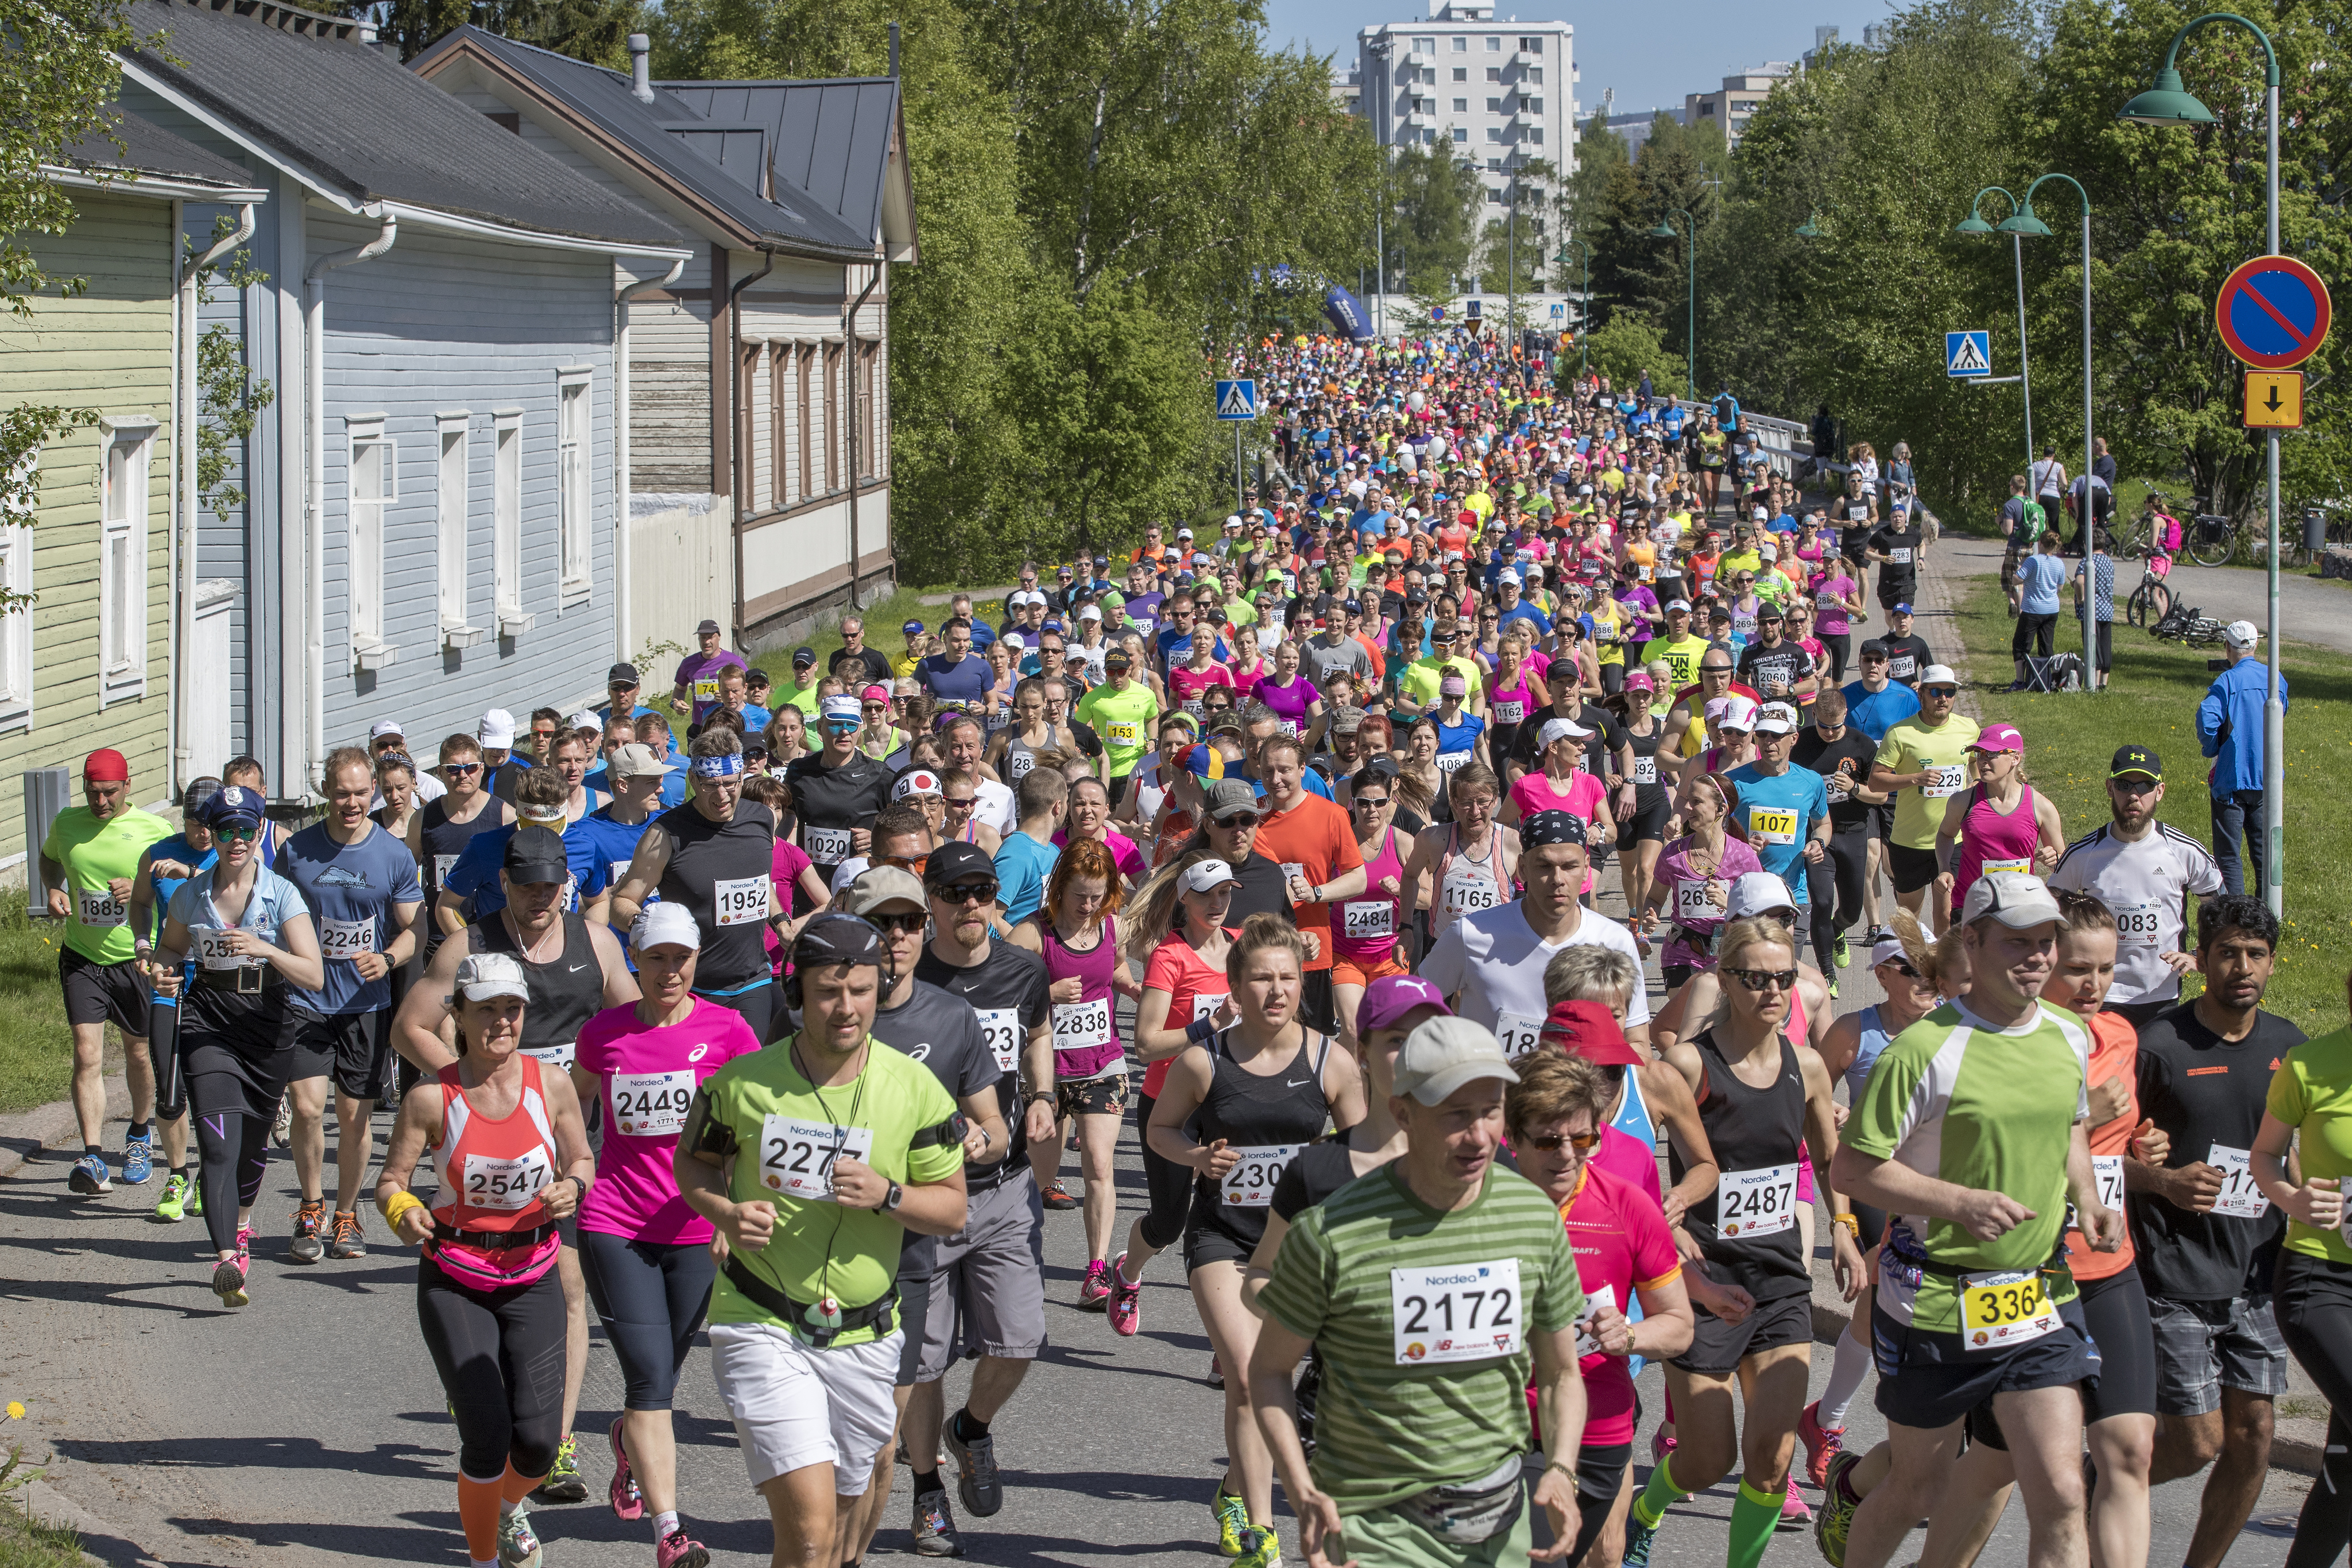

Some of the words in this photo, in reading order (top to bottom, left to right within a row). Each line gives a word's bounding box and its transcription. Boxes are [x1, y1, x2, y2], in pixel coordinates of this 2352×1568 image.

[1136, 624, 1151, 632] 955
[1736, 620, 1757, 628] 2694
[1753, 656, 1774, 664] TOUGH
[1086, 664, 1098, 672] 41
[1890, 661, 1913, 672] 1096
[1671, 668, 1689, 679] OC
[1760, 673, 1785, 682] 2060
[702, 684, 715, 694] 74
[1183, 705, 1205, 715] 275
[1497, 707, 1521, 717] 1162
[1112, 727, 1132, 738] 153
[1283, 726, 1295, 735] 46
[1014, 758, 1030, 771] 28
[1440, 759, 1461, 770] 108
[1939, 773, 1962, 787] 229
[1758, 815, 1789, 832] 107
[807, 836, 846, 855] 1020
[721, 890, 767, 912] 1952
[1446, 887, 1492, 908] 1165
[81, 899, 125, 916] 1885
[1348, 911, 1390, 927] 2484
[2117, 913, 2158, 932] 083
[322, 928, 372, 947] 2246
[1056, 1011, 1107, 1035] 2838
[1519, 1021, 1542, 1031] Norde
[985, 1027, 1014, 1053] 23
[1502, 1029, 1536, 1054] 18
[530, 1051, 555, 1060] ordea
[617, 1088, 691, 1117] 2449
[656, 1117, 674, 1125] 1771
[790, 1125, 832, 1139] Nordea
[2230, 1154, 2250, 1163] Nord
[486, 1163, 521, 1171] Nordea
[2093, 1160, 2112, 1170] rdea
[469, 1164, 546, 1195] 2547
[1227, 1162, 1285, 1188] 230
[1741, 1174, 1772, 1185] Nordea
[2102, 1175, 2122, 1206] 74
[1724, 1182, 1792, 1218] 2487
[1425, 1273, 1477, 1286] Nordea
[1984, 1275, 2022, 1286] Nordea
[1979, 1285, 2036, 1323] 336
[1403, 1287, 1512, 1334] 2172
[1467, 1341, 1490, 1349] balance
